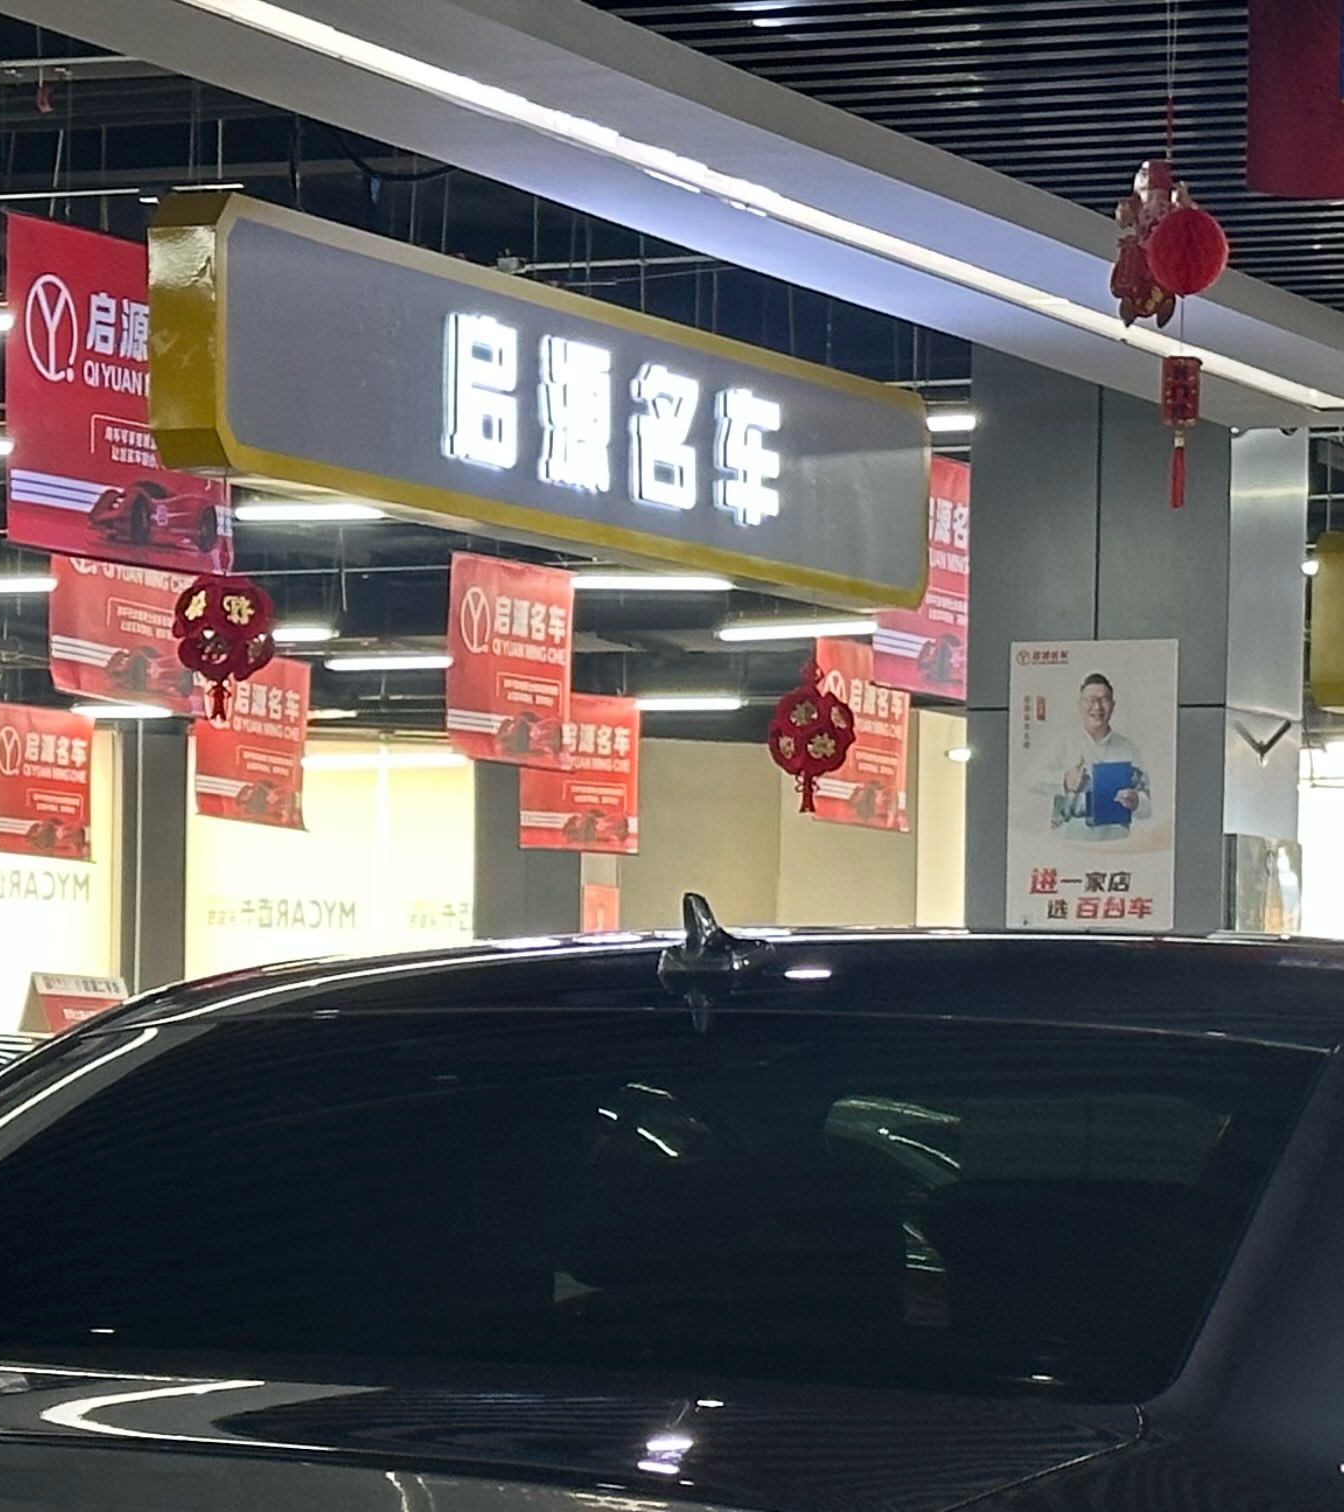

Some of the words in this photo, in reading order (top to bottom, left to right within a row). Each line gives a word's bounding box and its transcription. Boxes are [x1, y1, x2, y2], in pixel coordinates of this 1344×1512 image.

[84, 360, 99, 387] QI
[101, 364, 142, 396] YUAN
[442, 312, 780, 527] 启源名车
[494, 595, 566, 645] 启源名车
[1029, 868, 1132, 894] 进一家店
